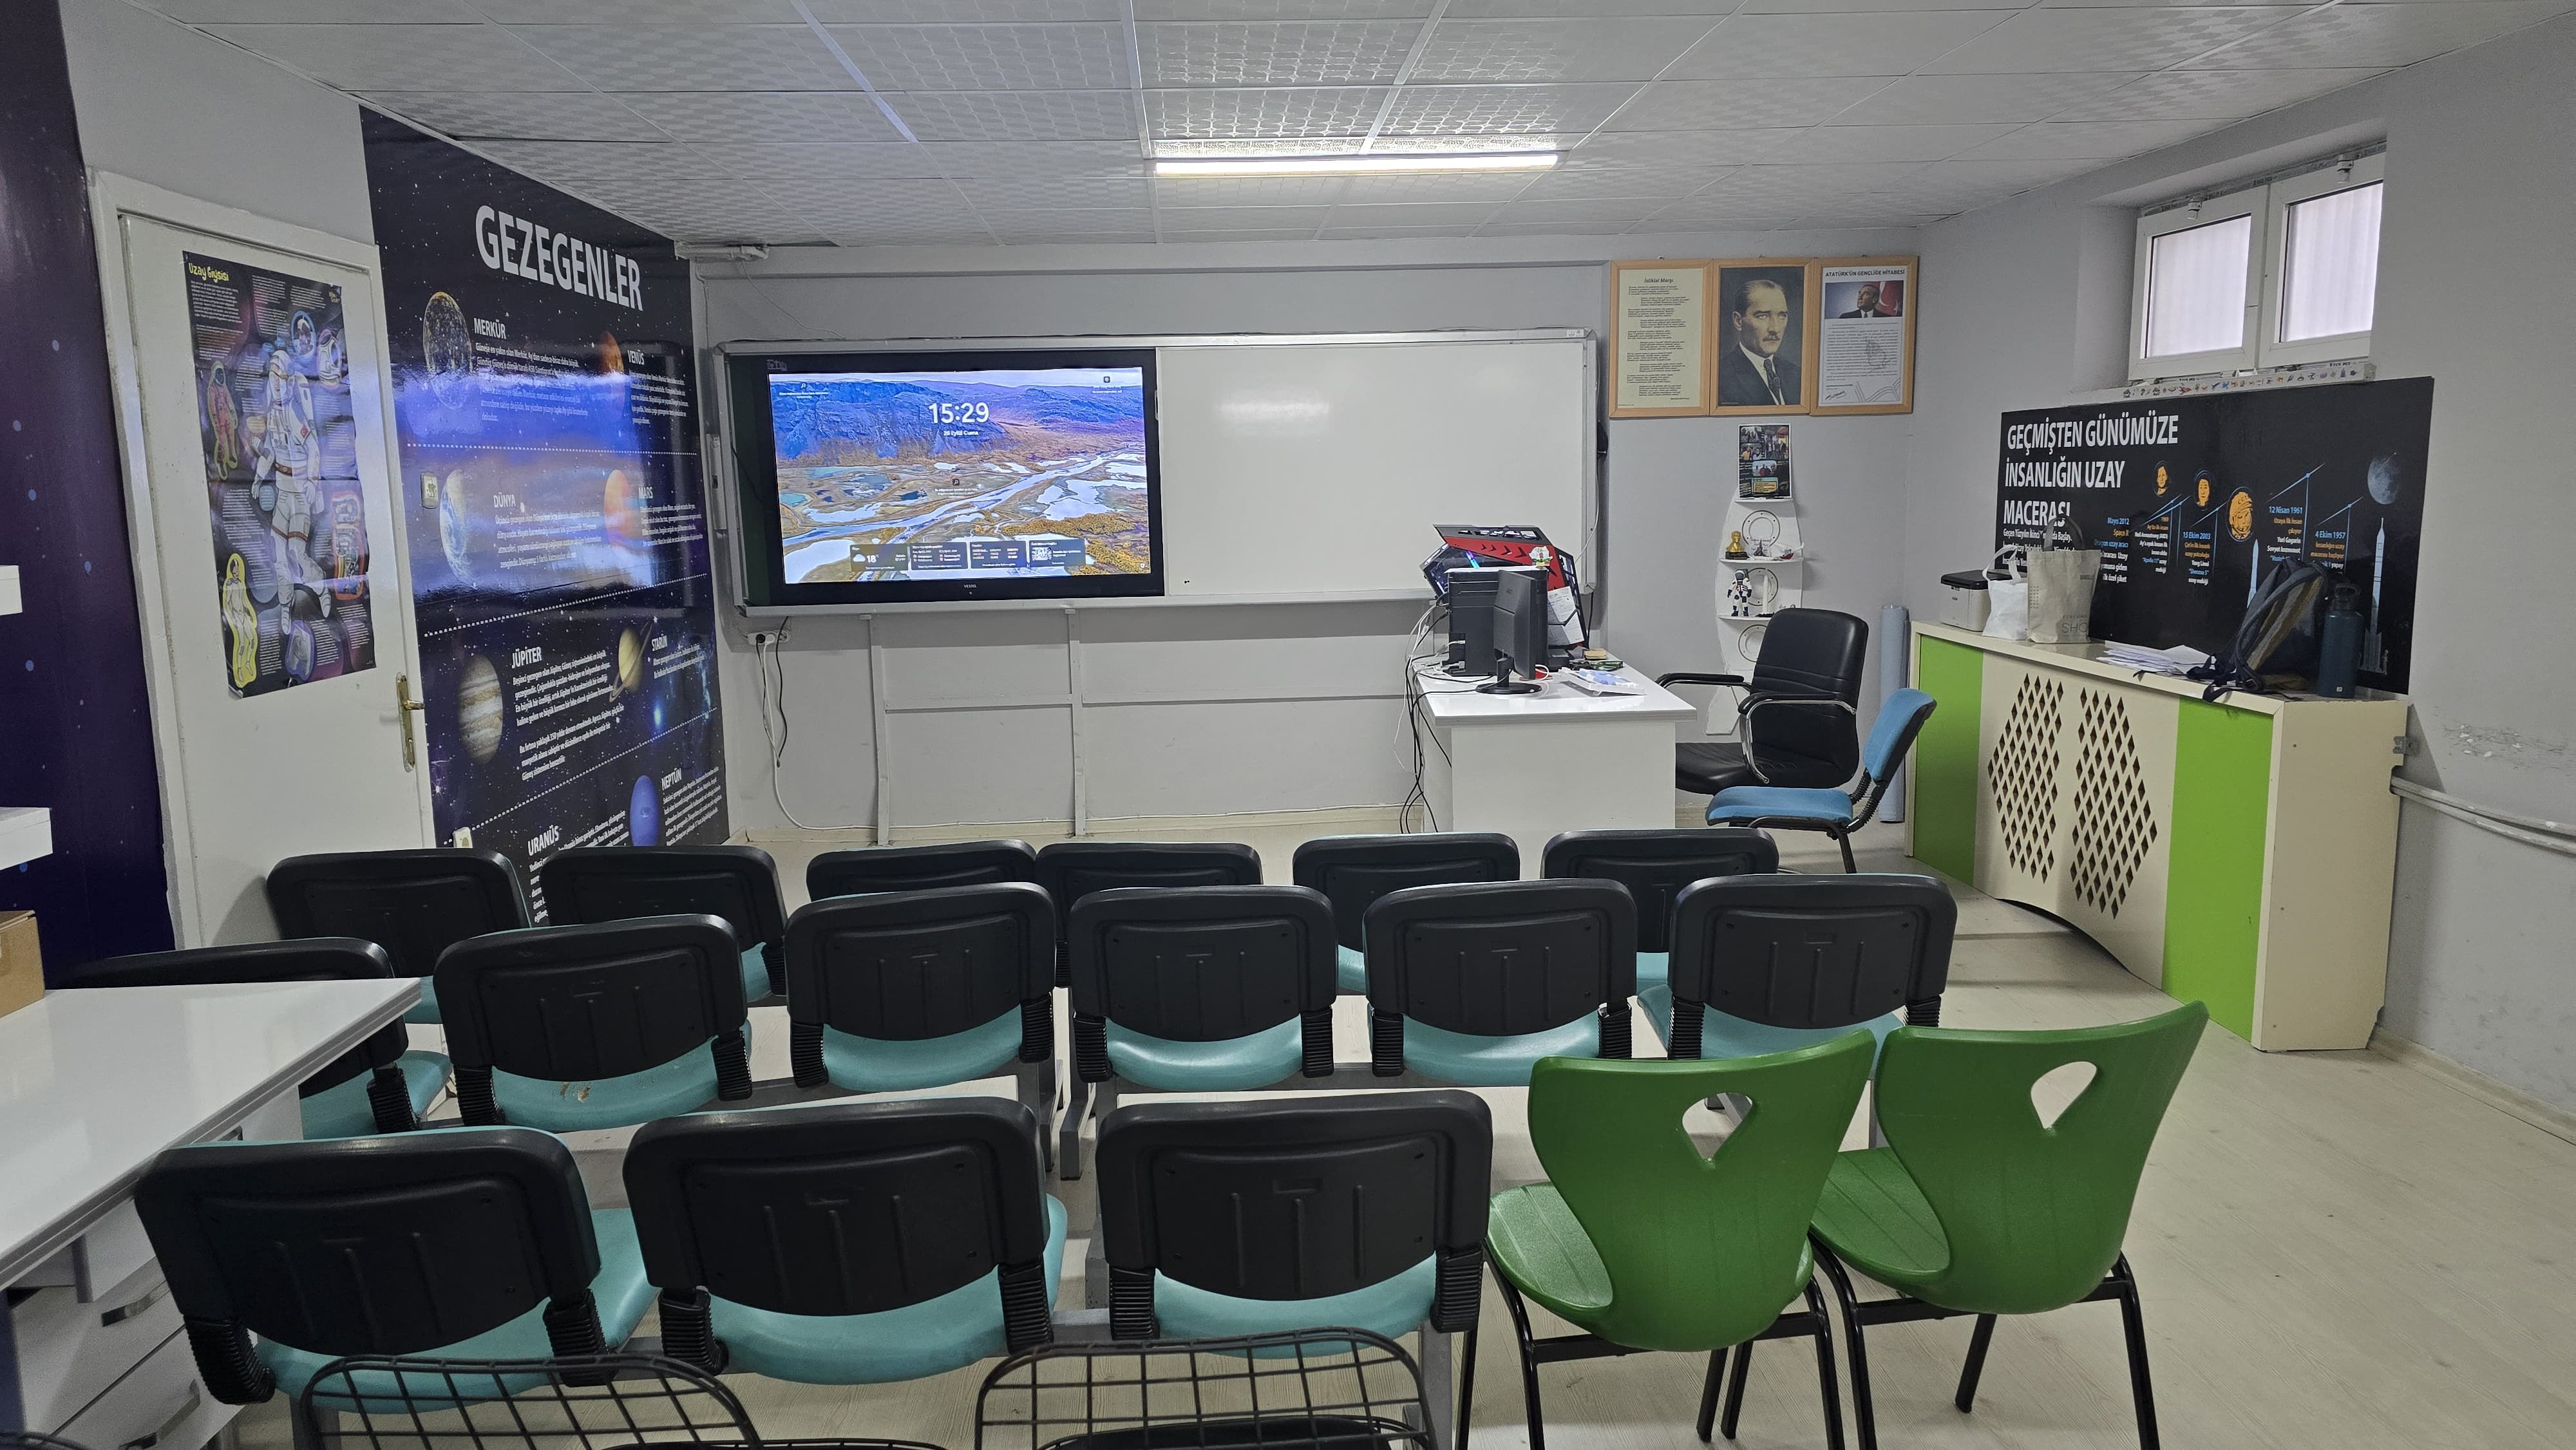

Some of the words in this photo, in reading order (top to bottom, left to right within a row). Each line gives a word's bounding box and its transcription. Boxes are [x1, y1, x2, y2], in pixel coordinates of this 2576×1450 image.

[475, 205, 643, 311] GEZEGENLER
[188, 263, 206, 281] Uzay
[207, 267, 229, 283] Giysisi
[474, 318, 506, 339] MERKÜR
[929, 402, 989, 424] 15:29
[2007, 417, 2082, 455] GEÇMİŞTEN
[2085, 410, 2178, 447] GÜNÜMÜZE
[2005, 456, 2081, 488] İNSANLIĞIN
[2085, 460, 2125, 488] UZAY
[493, 492, 516, 507] DÜNYA
[639, 487, 653, 498] MARS
[2114, 529, 2125, 538] Space
[512, 646, 542, 668] JÜPİTER
[661, 767, 681, 790] NEPTÜN
[527, 825, 559, 856] URANÜS
